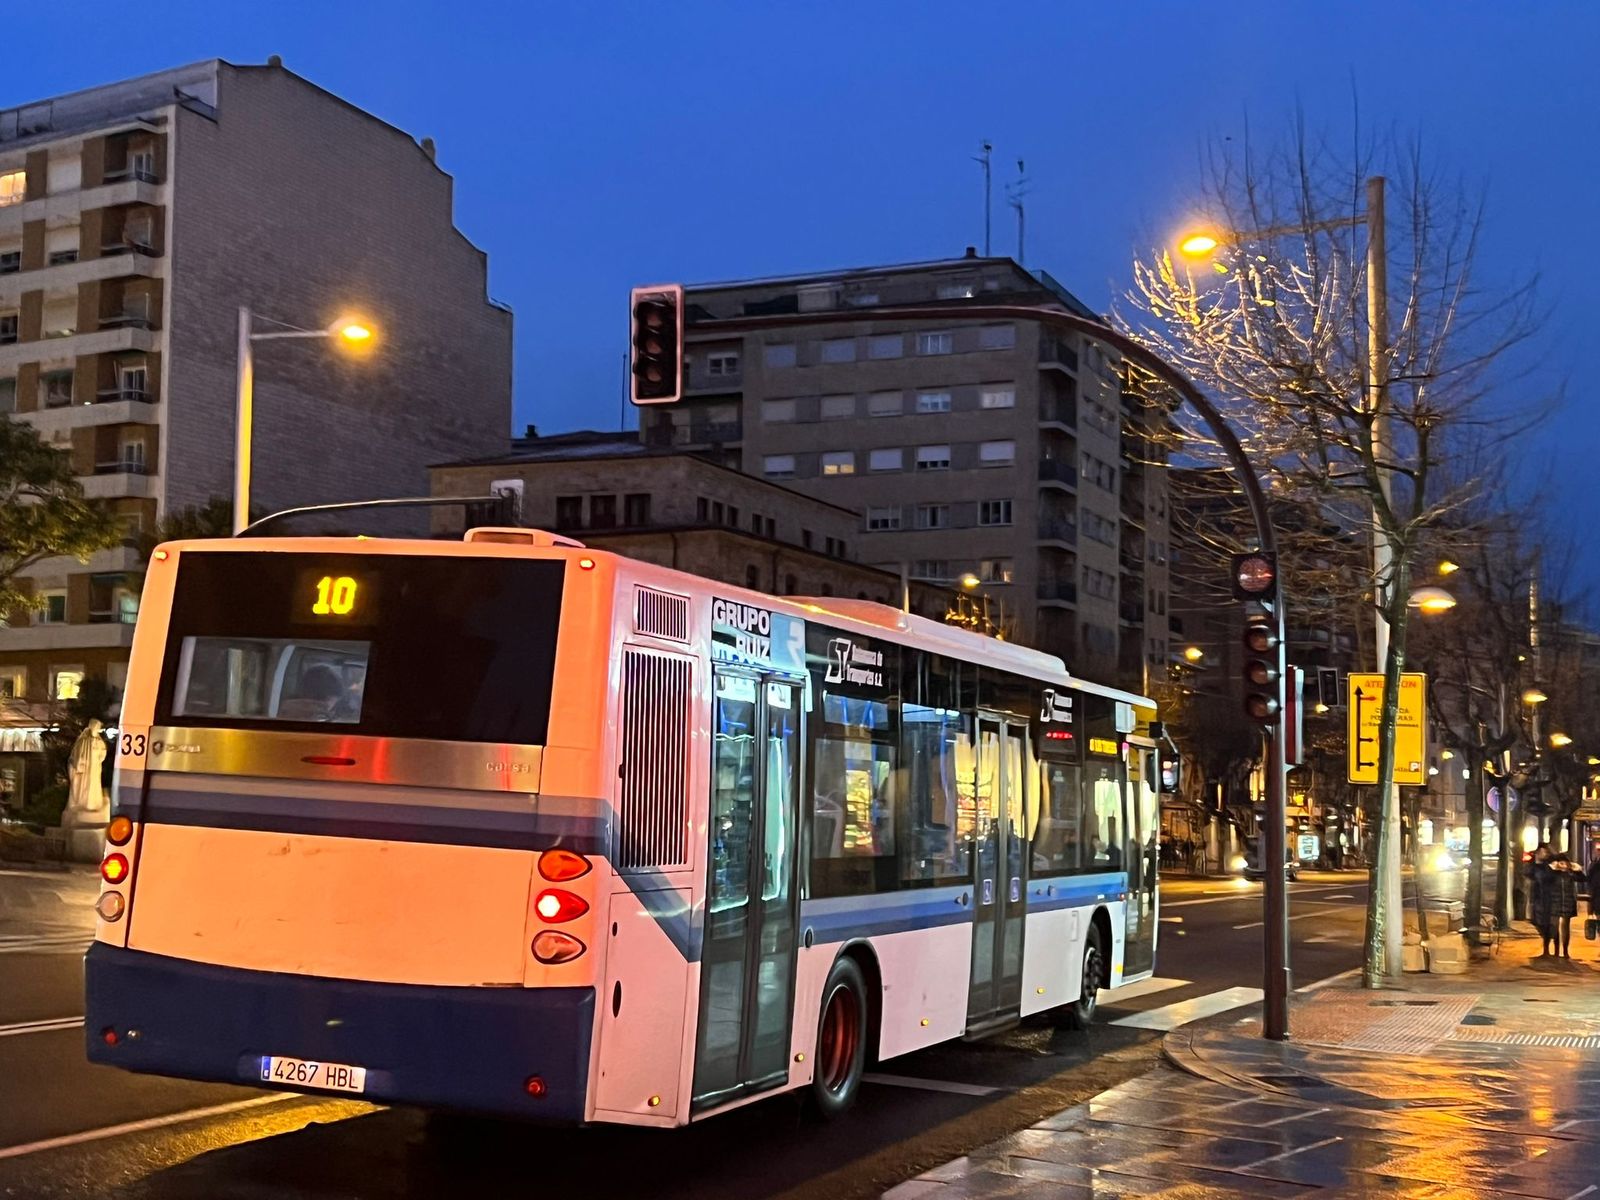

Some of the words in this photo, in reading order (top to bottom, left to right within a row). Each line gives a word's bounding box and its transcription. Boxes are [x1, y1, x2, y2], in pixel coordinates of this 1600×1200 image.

[312, 576, 357, 615] 10
[714, 600, 770, 635] GRUPO
[735, 633, 770, 660] RUIZ
[1364, 680, 1417, 689] ATEON
[121, 734, 145, 756] 33
[274, 1060, 319, 1083] 4267
[325, 1066, 359, 1089] HBL
